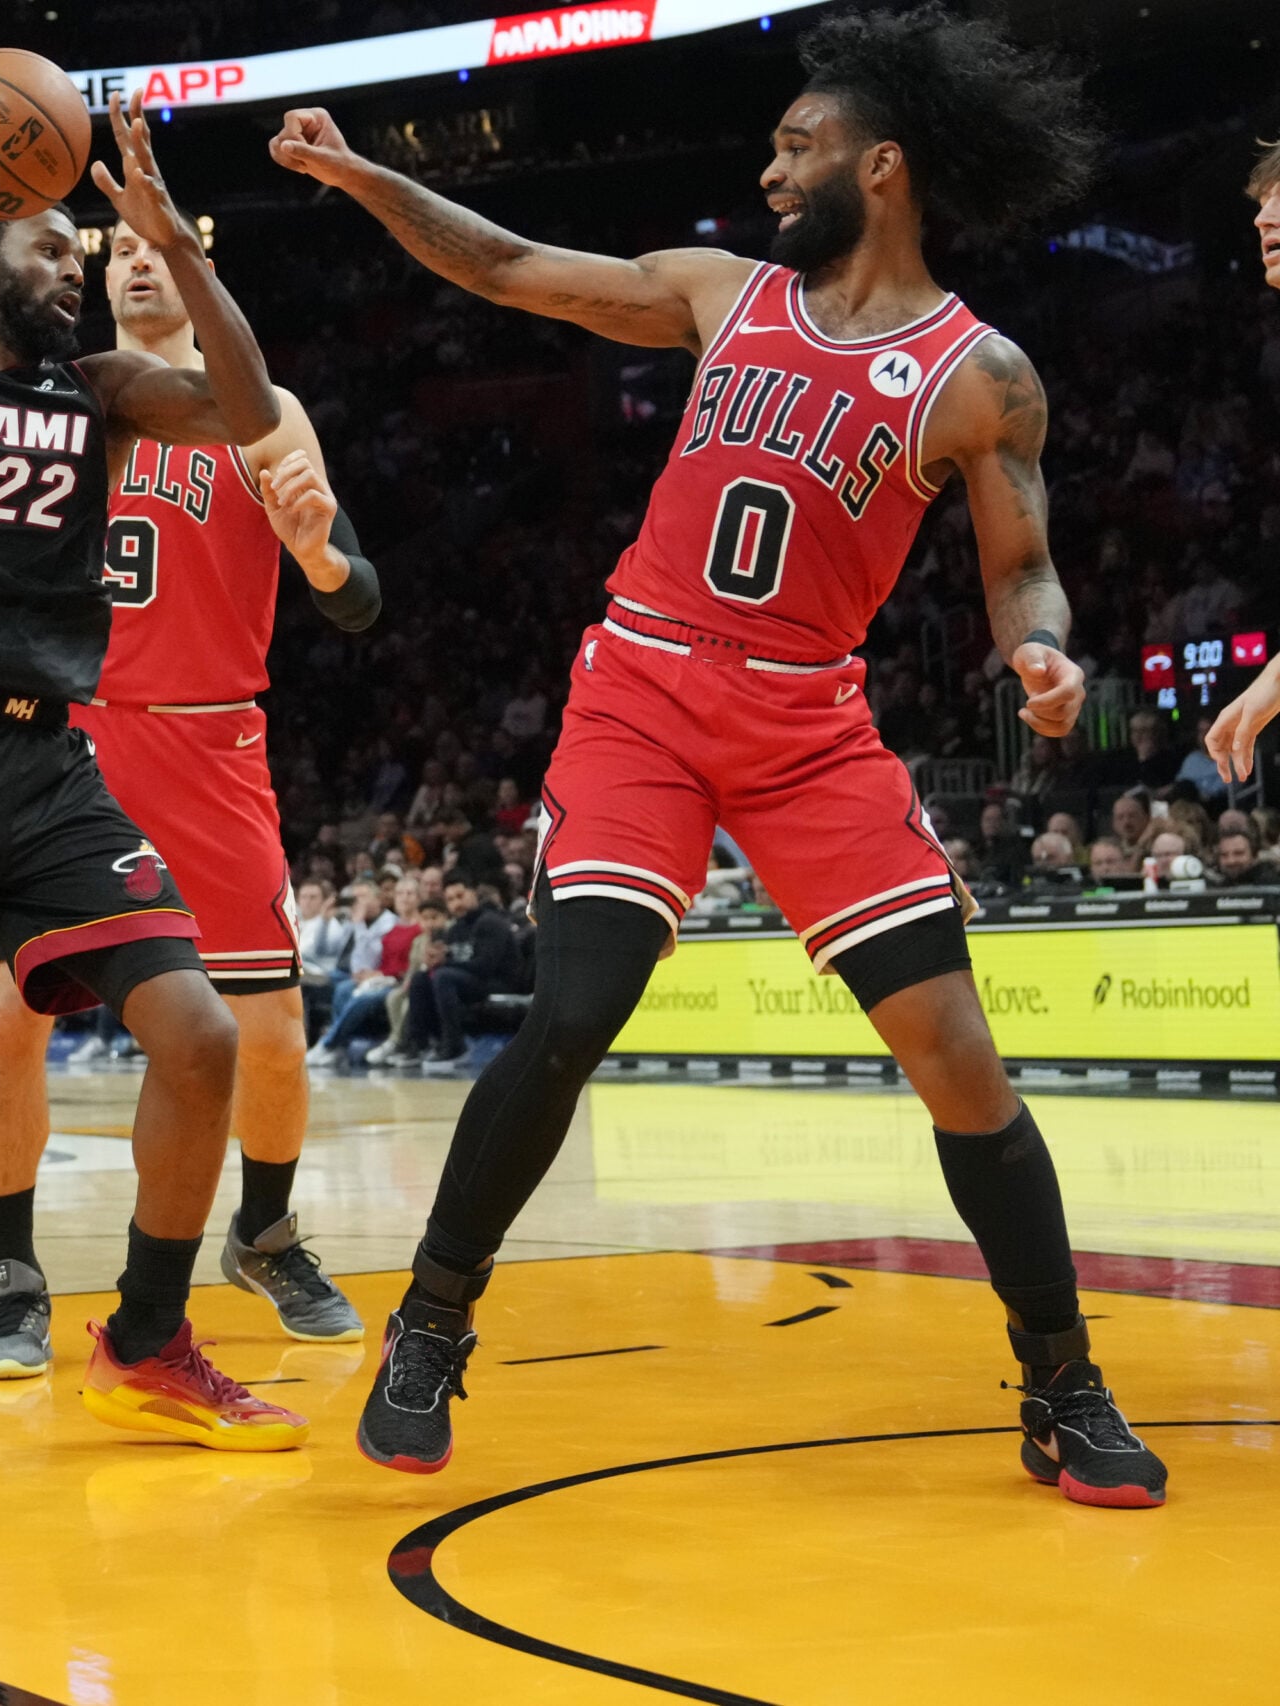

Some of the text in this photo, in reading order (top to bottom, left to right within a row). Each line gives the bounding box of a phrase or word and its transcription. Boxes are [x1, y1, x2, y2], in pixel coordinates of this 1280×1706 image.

[495, 9, 644, 58] PAPAJOHNS
[80, 75, 125, 107] HE
[143, 65, 245, 104] APP
[679, 363, 904, 522] BULLS
[120, 438, 217, 526] LLS
[101, 515, 160, 609] 9
[703, 475, 797, 606] 0
[1183, 639, 1224, 670] 9:00
[638, 982, 719, 1012] obinhood
[747, 977, 804, 1015] Your
[1121, 977, 1251, 1009] Robinhood
